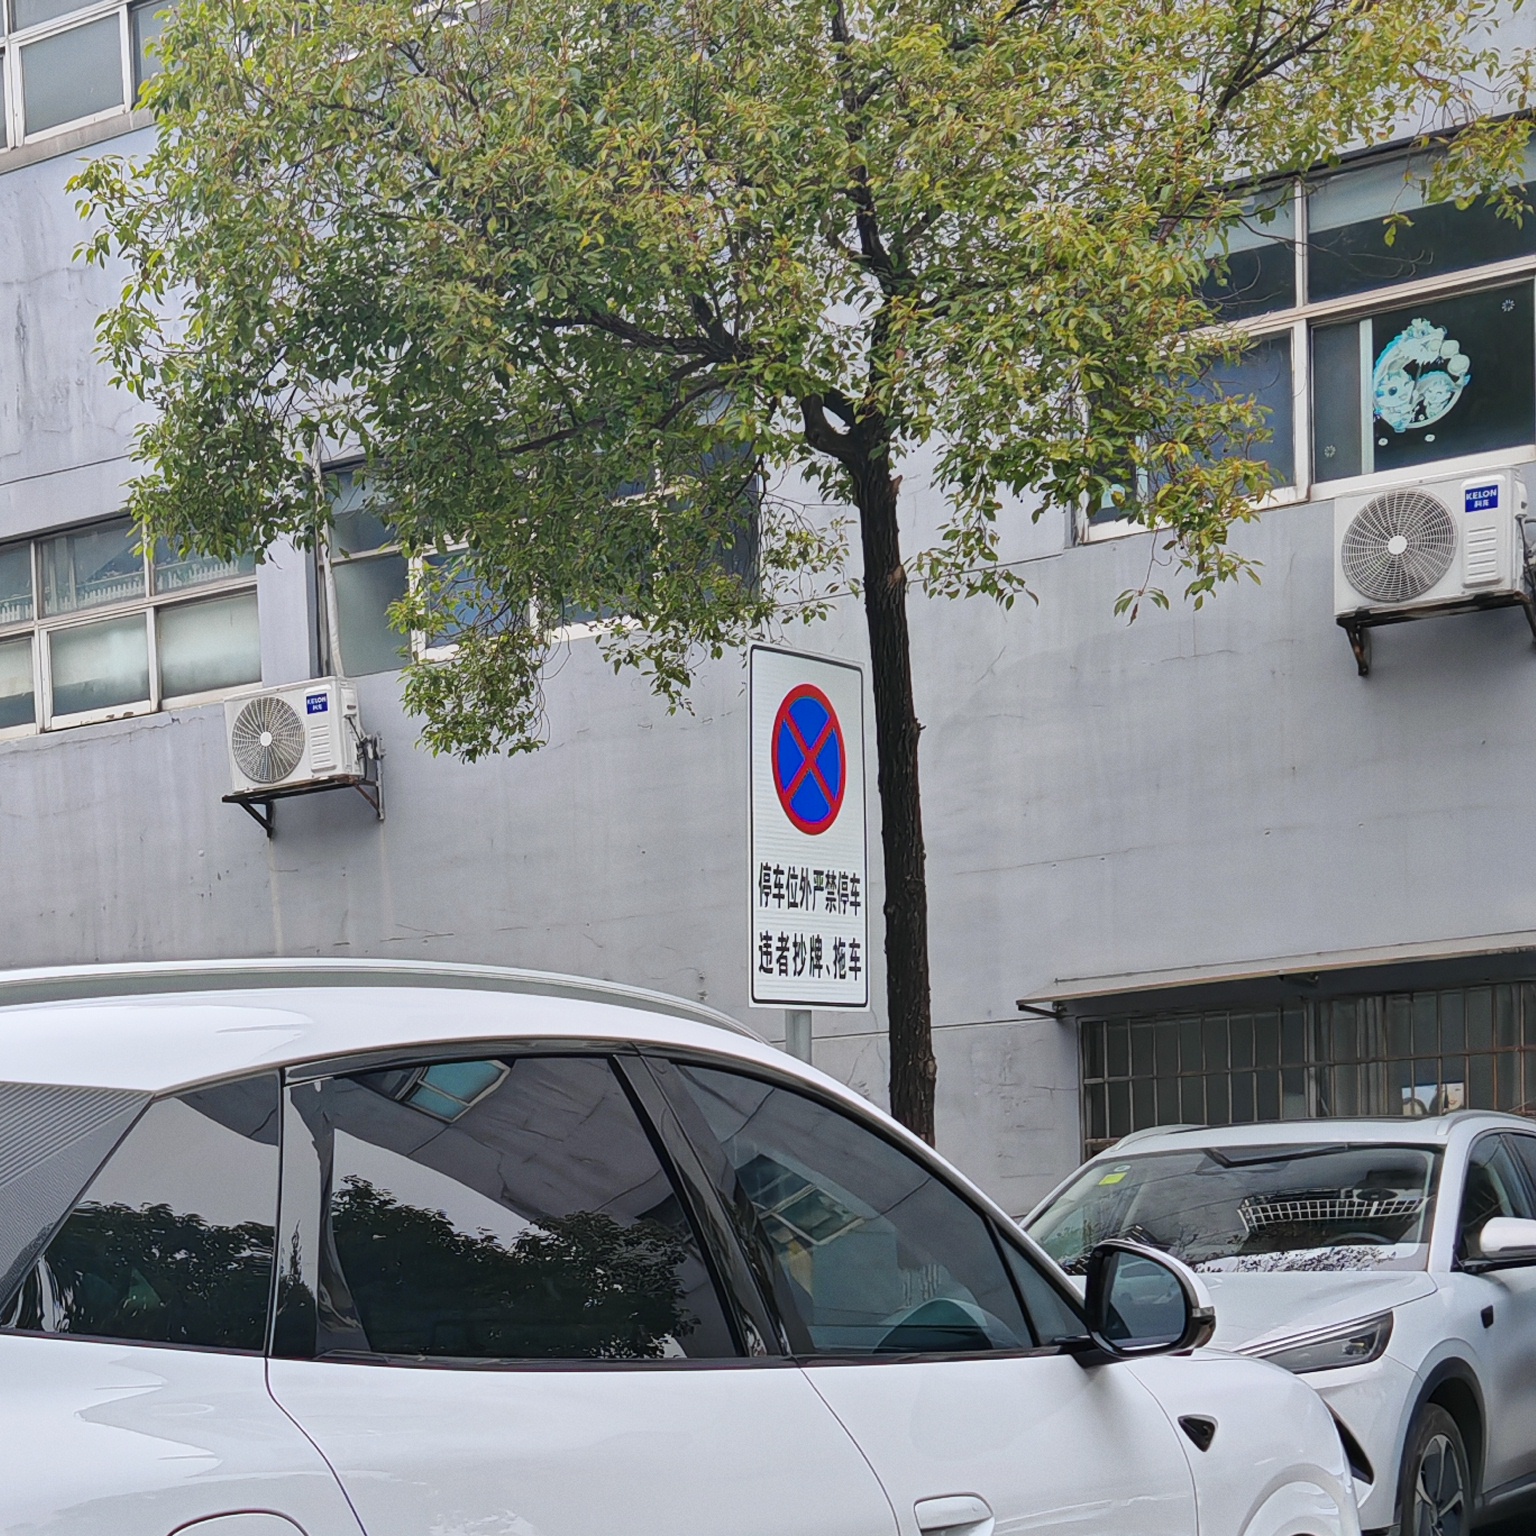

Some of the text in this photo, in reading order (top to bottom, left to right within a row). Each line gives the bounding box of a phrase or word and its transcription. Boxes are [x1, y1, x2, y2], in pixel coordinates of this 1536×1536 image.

[1466, 488, 1497, 501] KELON
[759, 862, 861, 916] 停车位外严禁停车
[758, 930, 862, 981] 违者抄牌、拖车
